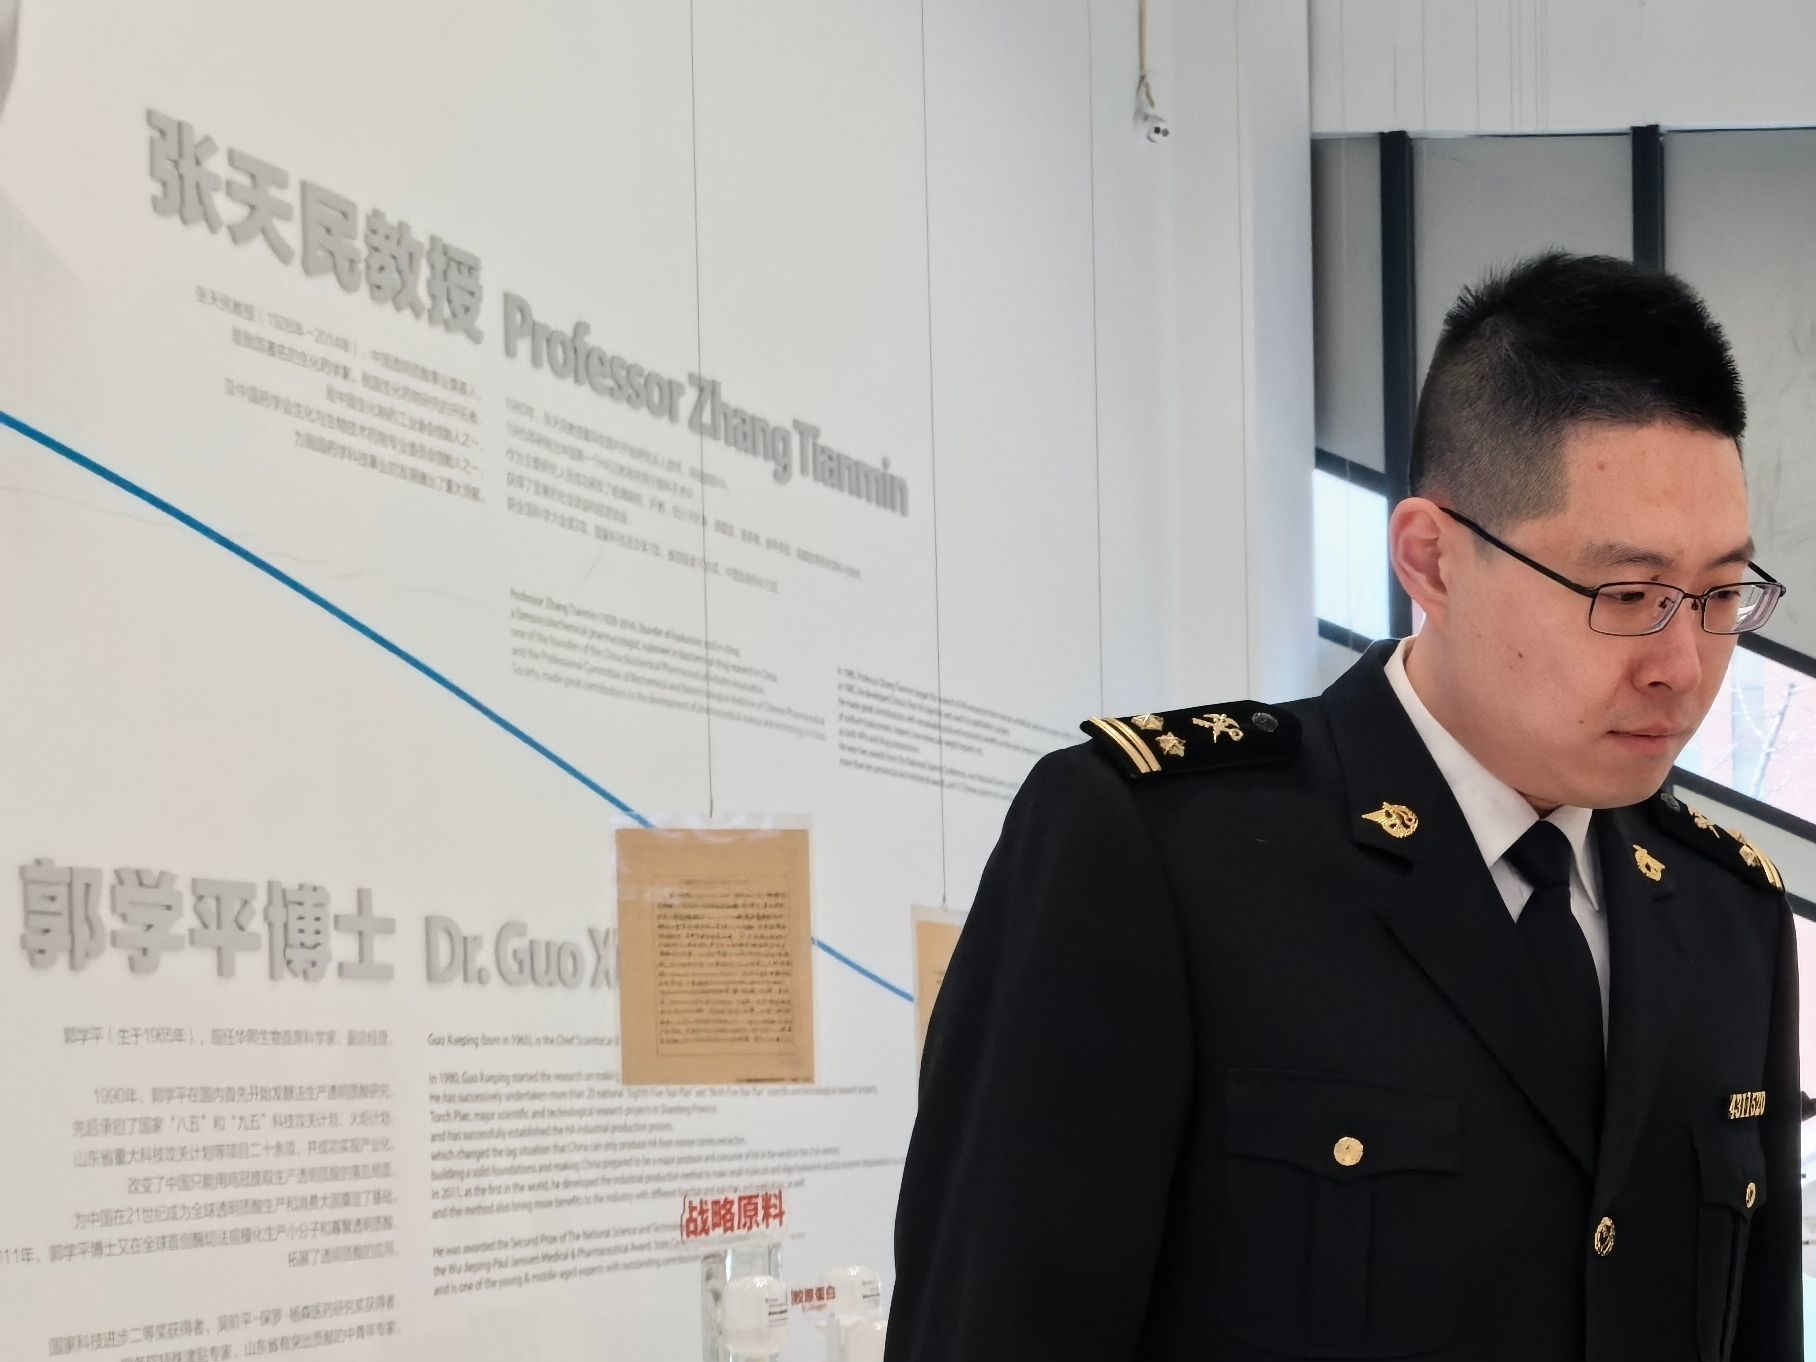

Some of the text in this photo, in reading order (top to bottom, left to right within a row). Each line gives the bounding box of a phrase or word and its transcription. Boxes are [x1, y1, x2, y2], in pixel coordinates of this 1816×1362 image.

[145, 108, 484, 345] 张天民教授
[503, 292, 686, 430] Professor
[687, 372, 793, 485] Zhang
[792, 417, 910, 518] Tianmin
[19, 858, 397, 984] 郭学平博士
[425, 915, 488, 985] Dr.
[494, 919, 582, 989] Guo
[684, 1188, 786, 1239] 战略原料
